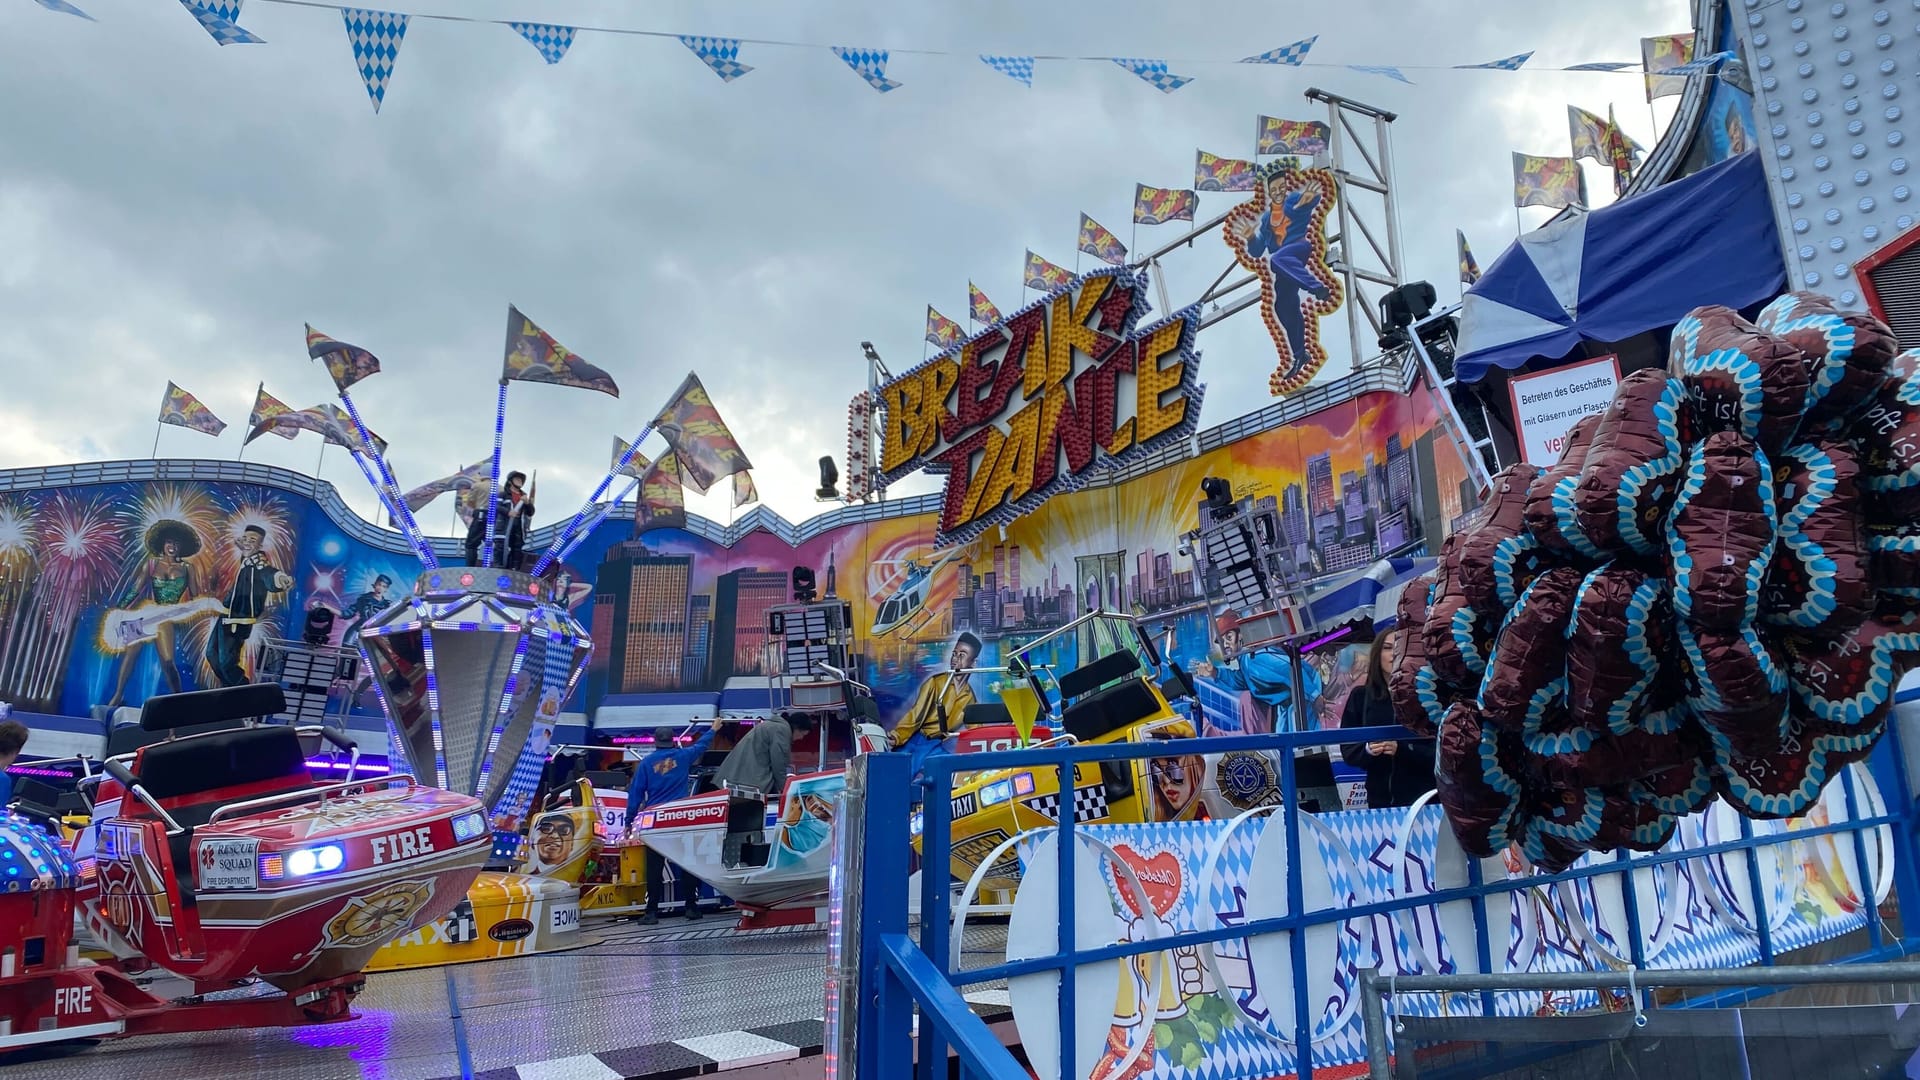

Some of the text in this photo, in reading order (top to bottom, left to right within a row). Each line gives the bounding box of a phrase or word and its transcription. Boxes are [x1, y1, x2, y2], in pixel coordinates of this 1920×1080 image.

[881, 275, 1122, 474] BREAK
[1521, 377, 1612, 405] Betreten des Geschäftes
[933, 318, 1190, 533] DANCE
[1524, 415, 1536, 426] mit
[1568, 405, 1582, 417] und
[1544, 431, 1568, 454] ver
[1227, 757, 1244, 770] YORK
[1245, 757, 1265, 776] POLICE
[656, 805, 725, 822] Emergency
[951, 795, 973, 819] TAXI
[217, 843, 255, 856] RESCUE
[370, 827, 434, 865] FIRE
[681, 831, 722, 866] 14
[219, 858, 252, 871] SQUAD
[207, 876, 250, 886] FIRE DEPARTMENT
[383, 917, 470, 948] AXI
[54, 985, 93, 1016] FIRE
